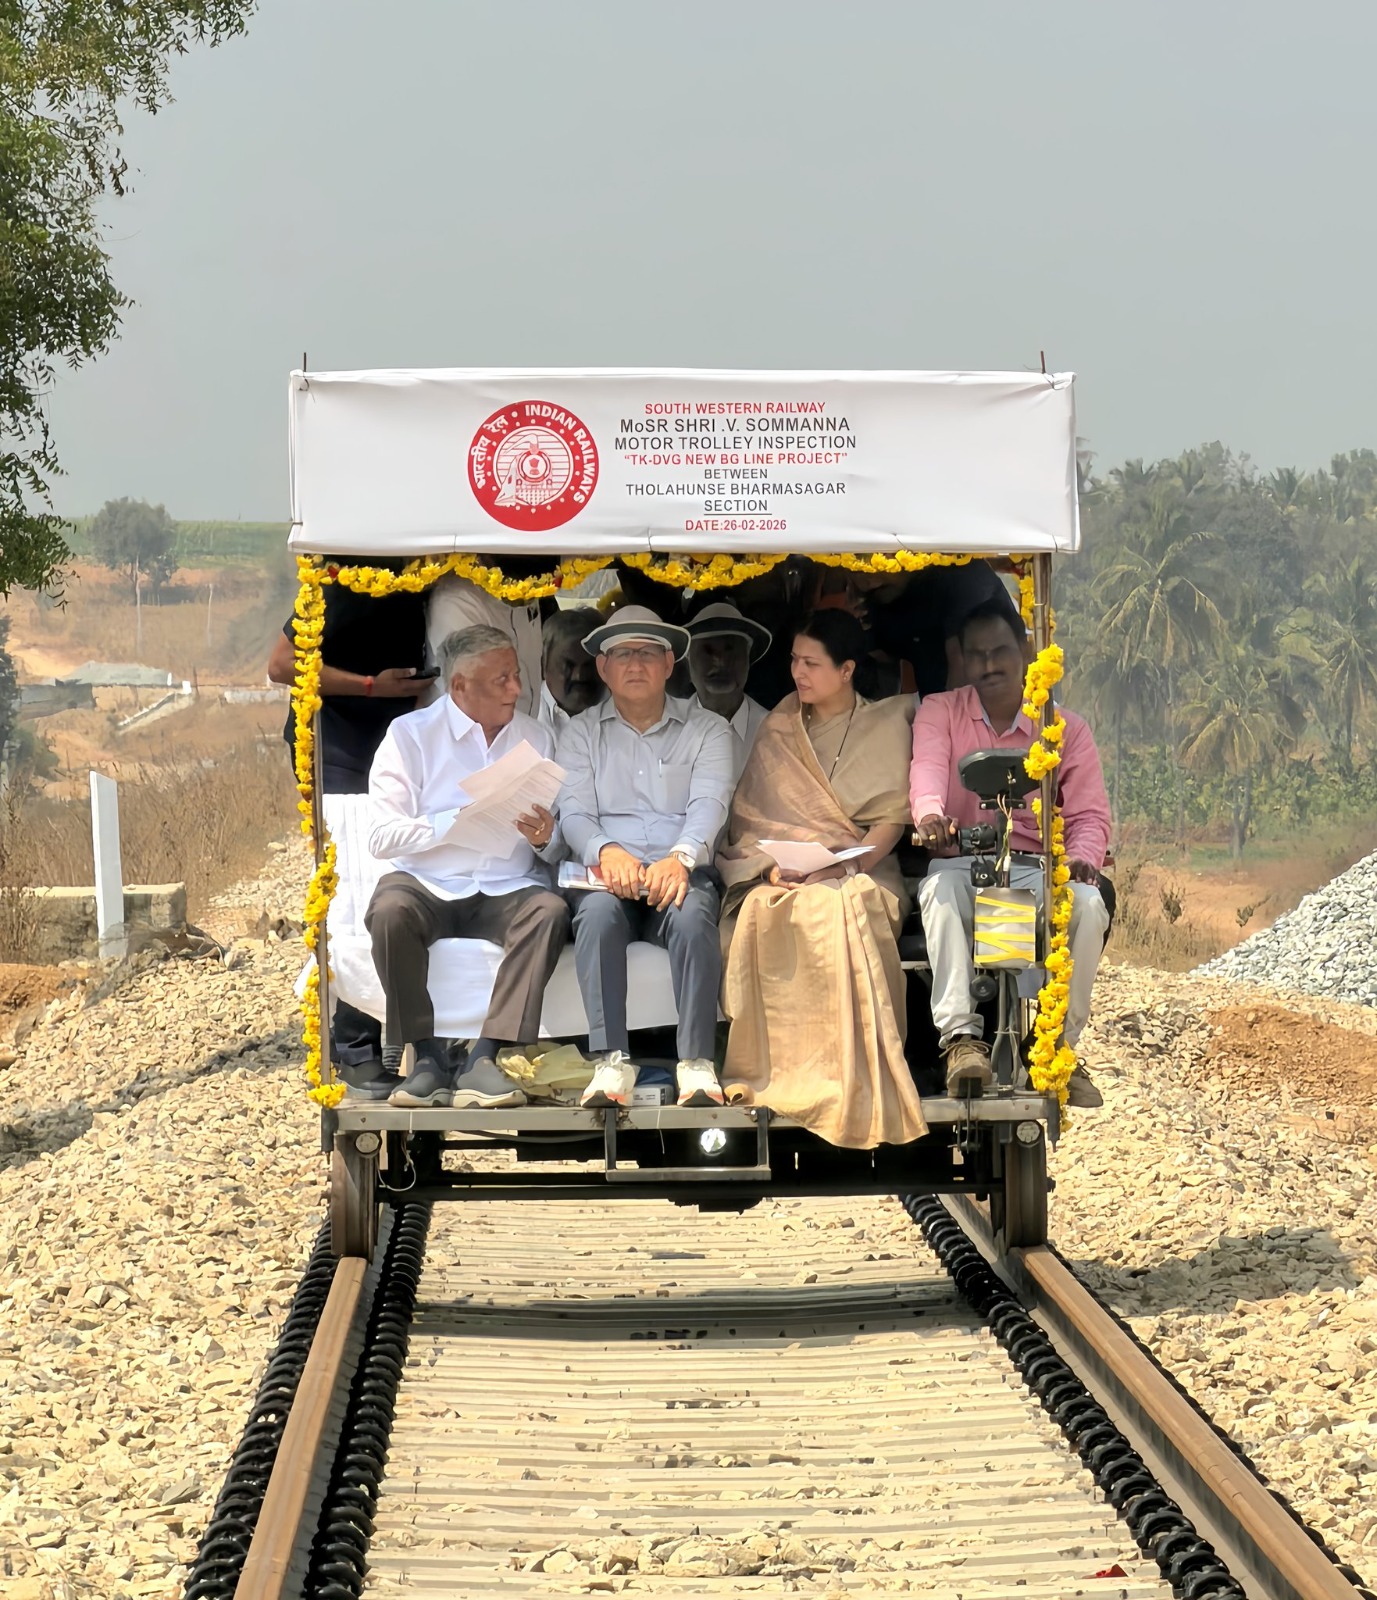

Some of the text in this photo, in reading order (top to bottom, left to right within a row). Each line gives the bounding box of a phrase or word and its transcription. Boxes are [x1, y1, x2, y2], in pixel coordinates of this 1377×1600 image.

[645, 402, 825, 414] SOUTH WESTERN RAILWAY
[621, 419, 668, 433] MoSR
[675, 419, 715, 432] SHRI
[746, 417, 850, 431] SOMMANNA
[615, 435, 855, 450] MOTOR TROLLEY INSPECTION
[471, 414, 508, 489] भारतीय रेल
[525, 404, 596, 504] INDIAN RAILWAYS
[686, 454, 716, 465] NEW
[721, 454, 739, 464] BG
[744, 453, 773, 464] LINE
[705, 469, 767, 479] BETWEEN
[626, 483, 845, 495] THOLAHUNSE BHARMASAGAR
[705, 500, 767, 511] SECTION
[685, 519, 787, 531] DATE:26-02-2026
